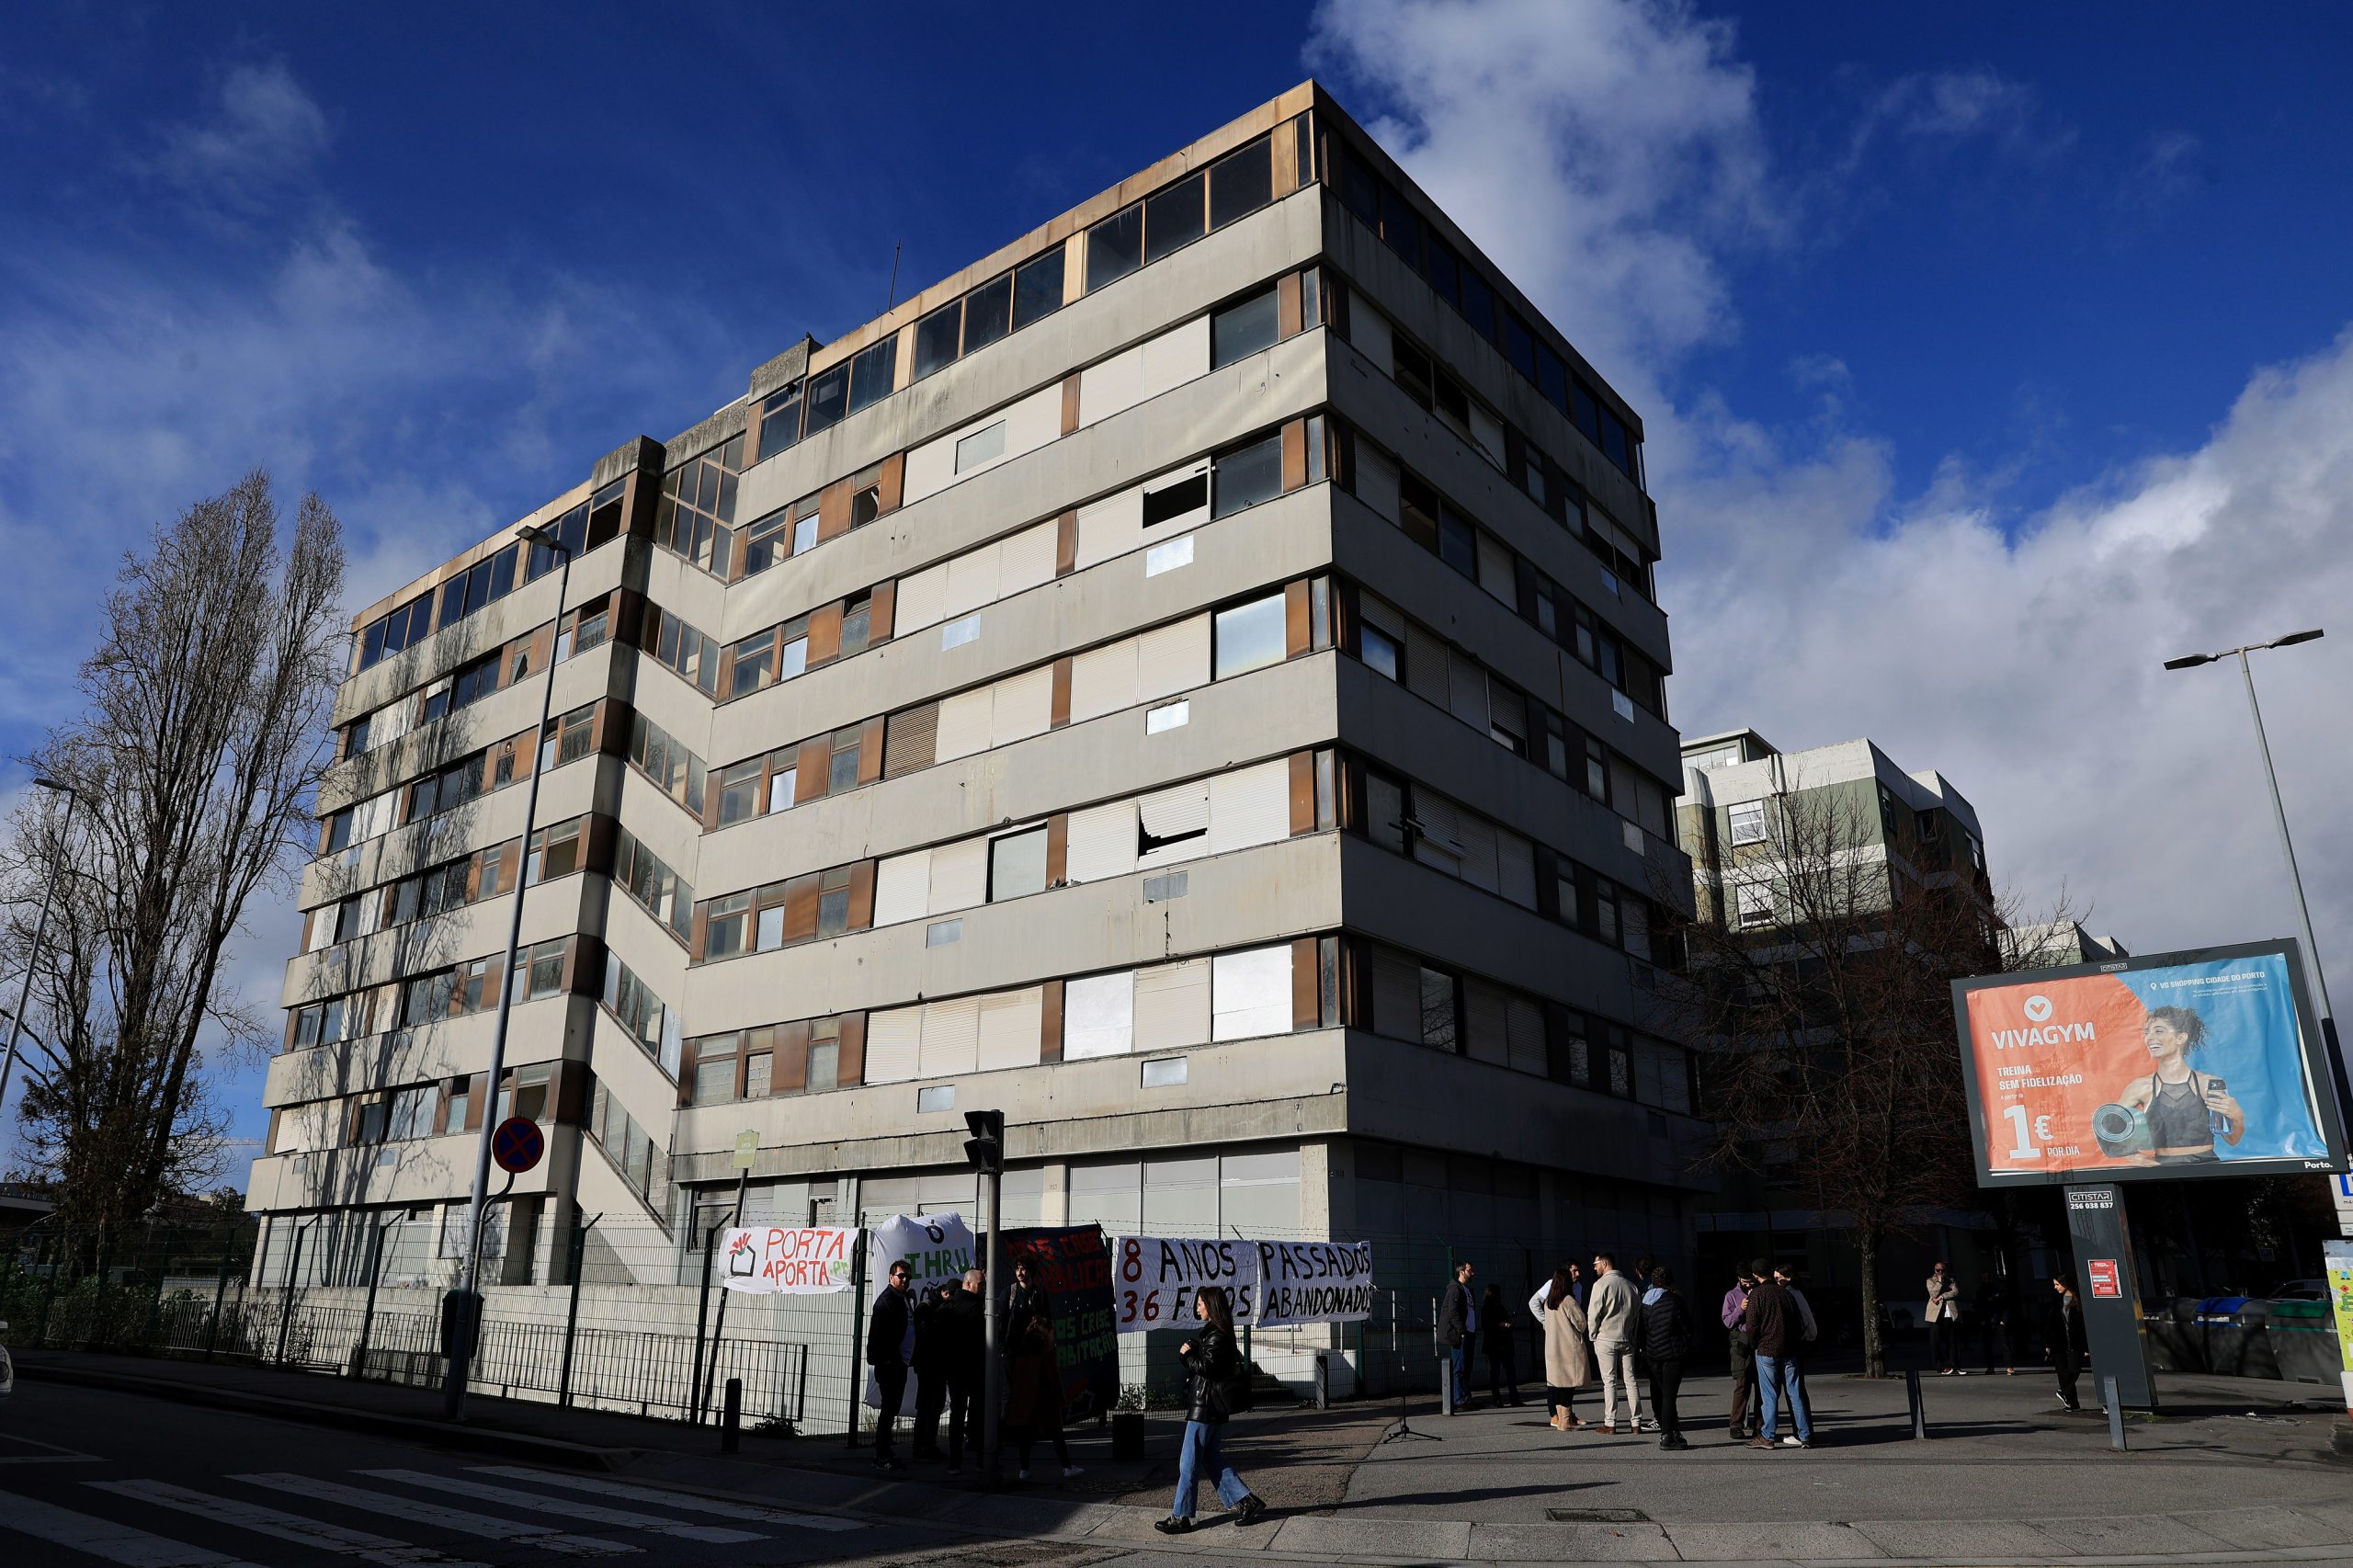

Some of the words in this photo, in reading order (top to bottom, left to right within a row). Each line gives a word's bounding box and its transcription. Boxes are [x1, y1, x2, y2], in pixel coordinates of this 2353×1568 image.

[2170, 978, 2205, 988] SHOPPING
[2206, 975, 2231, 984] CIDADE
[2242, 971, 2266, 981] PORTO
[1991, 1022, 2096, 1050] VIVAGYM
[1997, 1064, 2032, 1077] TREINA
[1999, 1079, 2020, 1090] SEM
[2021, 1073, 2083, 1088] FIDELIZAÇÃO
[2047, 1147, 2064, 1157] POR
[2065, 1145, 2081, 1155] DIA
[2304, 1161, 2334, 1169] Porto.
[766, 1228, 844, 1260] PORTA
[904, 1247, 970, 1280] IHRU
[1123, 1238, 1142, 1283] 8
[1160, 1240, 1236, 1284] ANOS
[1260, 1241, 1371, 1281] PASSADOS
[1121, 1290, 1159, 1323] 36
[1264, 1284, 1373, 1320] ABANDONADOS
[1057, 1329, 1117, 1367] ABITAÇÃO
